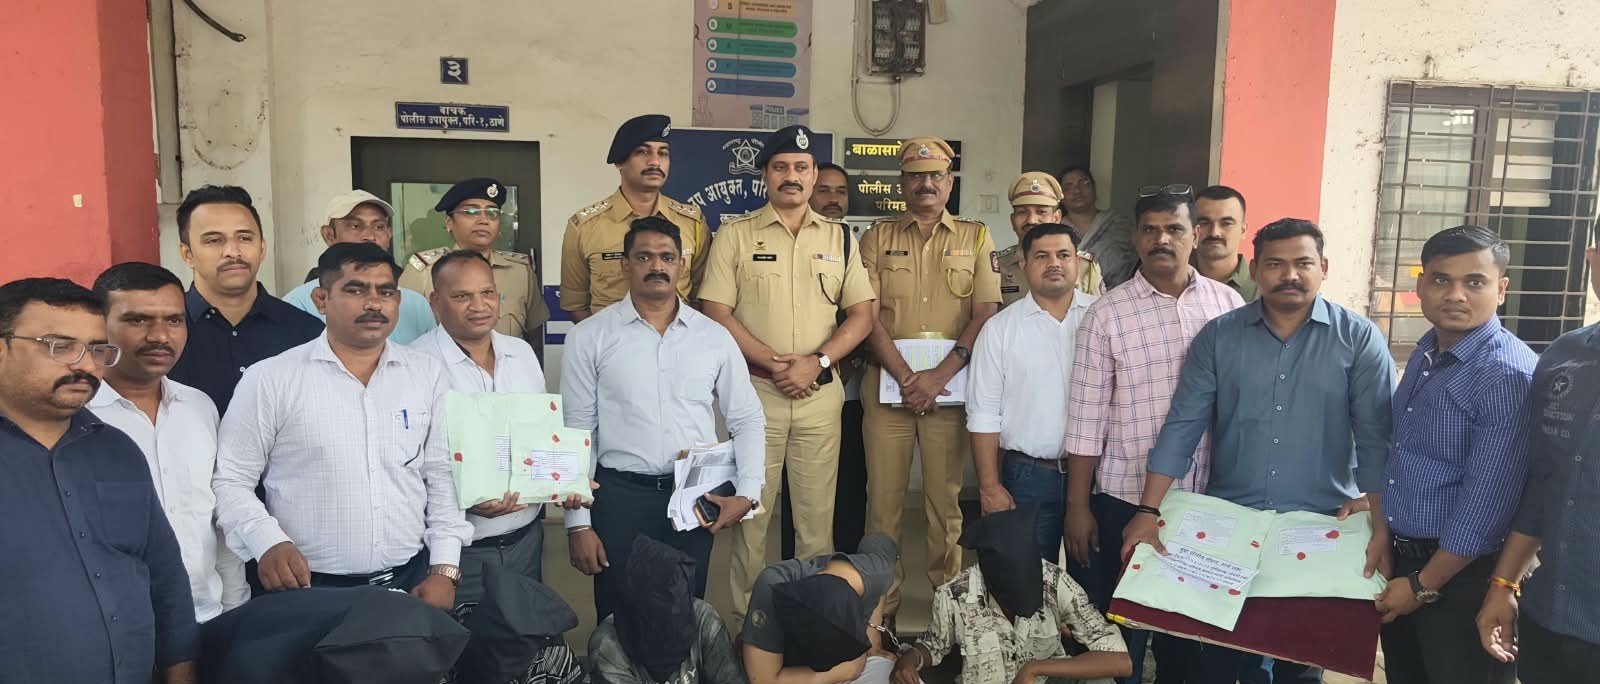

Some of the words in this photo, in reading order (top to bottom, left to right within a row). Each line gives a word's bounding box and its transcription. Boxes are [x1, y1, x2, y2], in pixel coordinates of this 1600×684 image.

[447, 61, 462, 81] ३
[440, 106, 467, 116] वाचक
[400, 112, 426, 124] पोलीस
[858, 180, 891, 194] पोलीस
